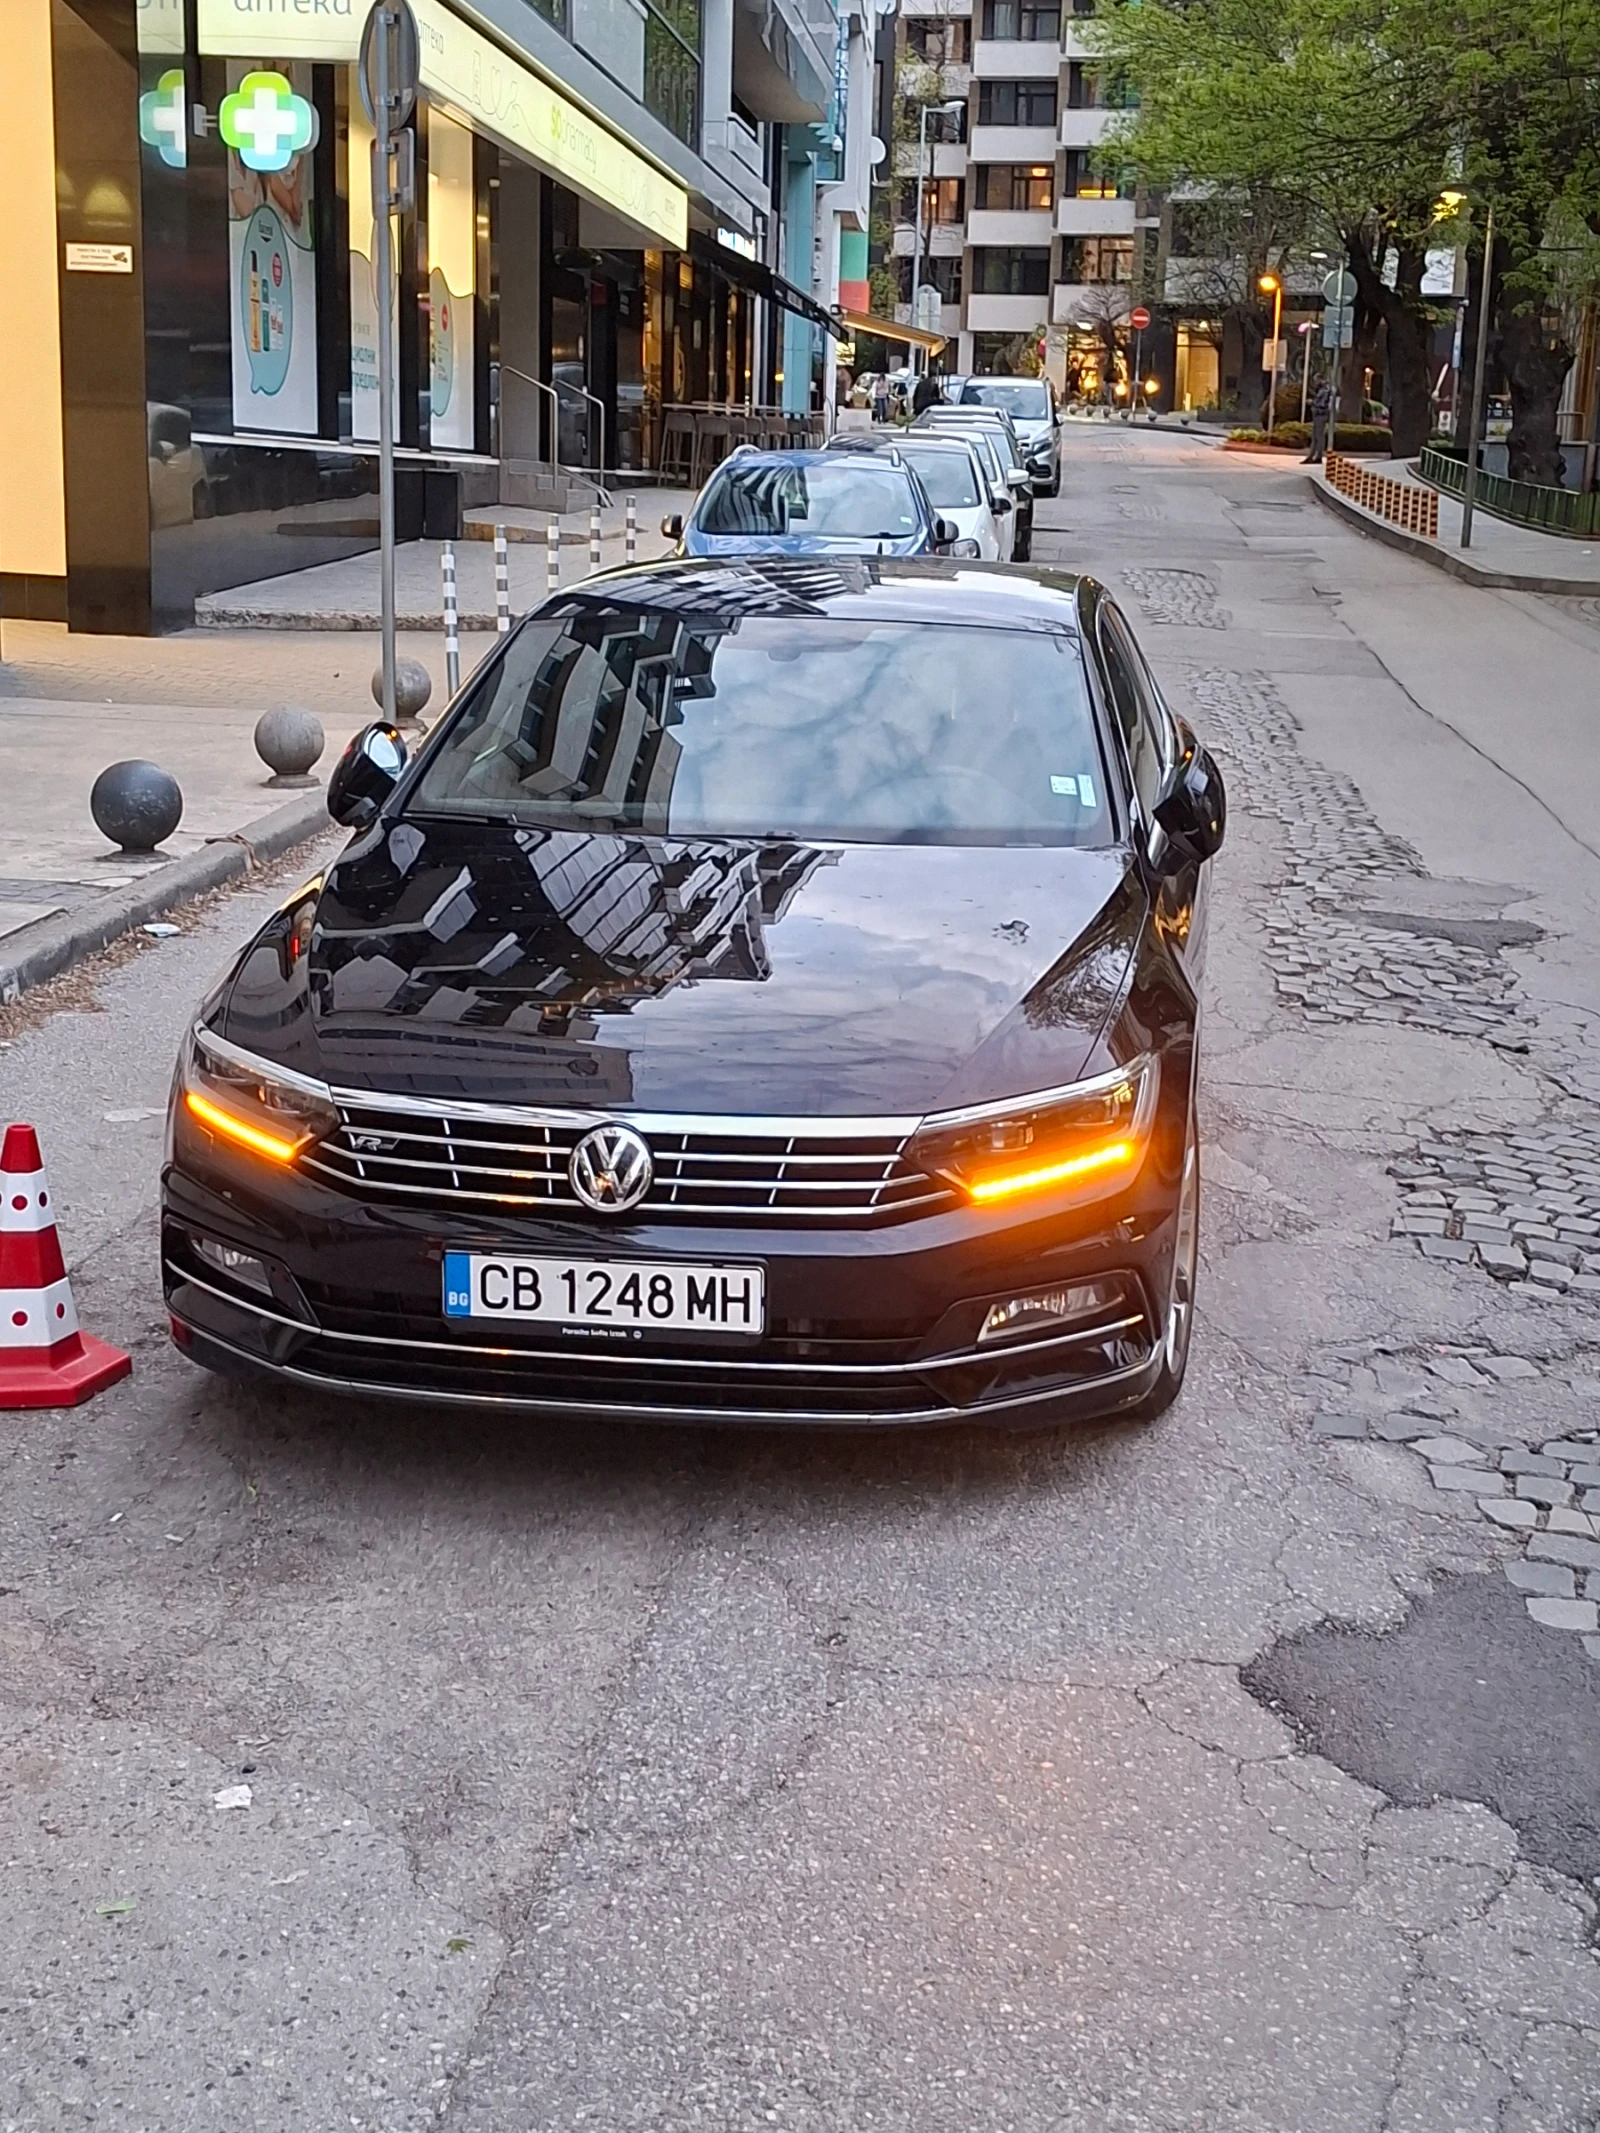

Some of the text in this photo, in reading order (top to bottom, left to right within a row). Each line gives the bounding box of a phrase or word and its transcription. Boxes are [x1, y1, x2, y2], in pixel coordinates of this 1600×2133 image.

[448, 1291, 469, 1307] BG
[480, 1264, 751, 1323] CB 1248 MH
